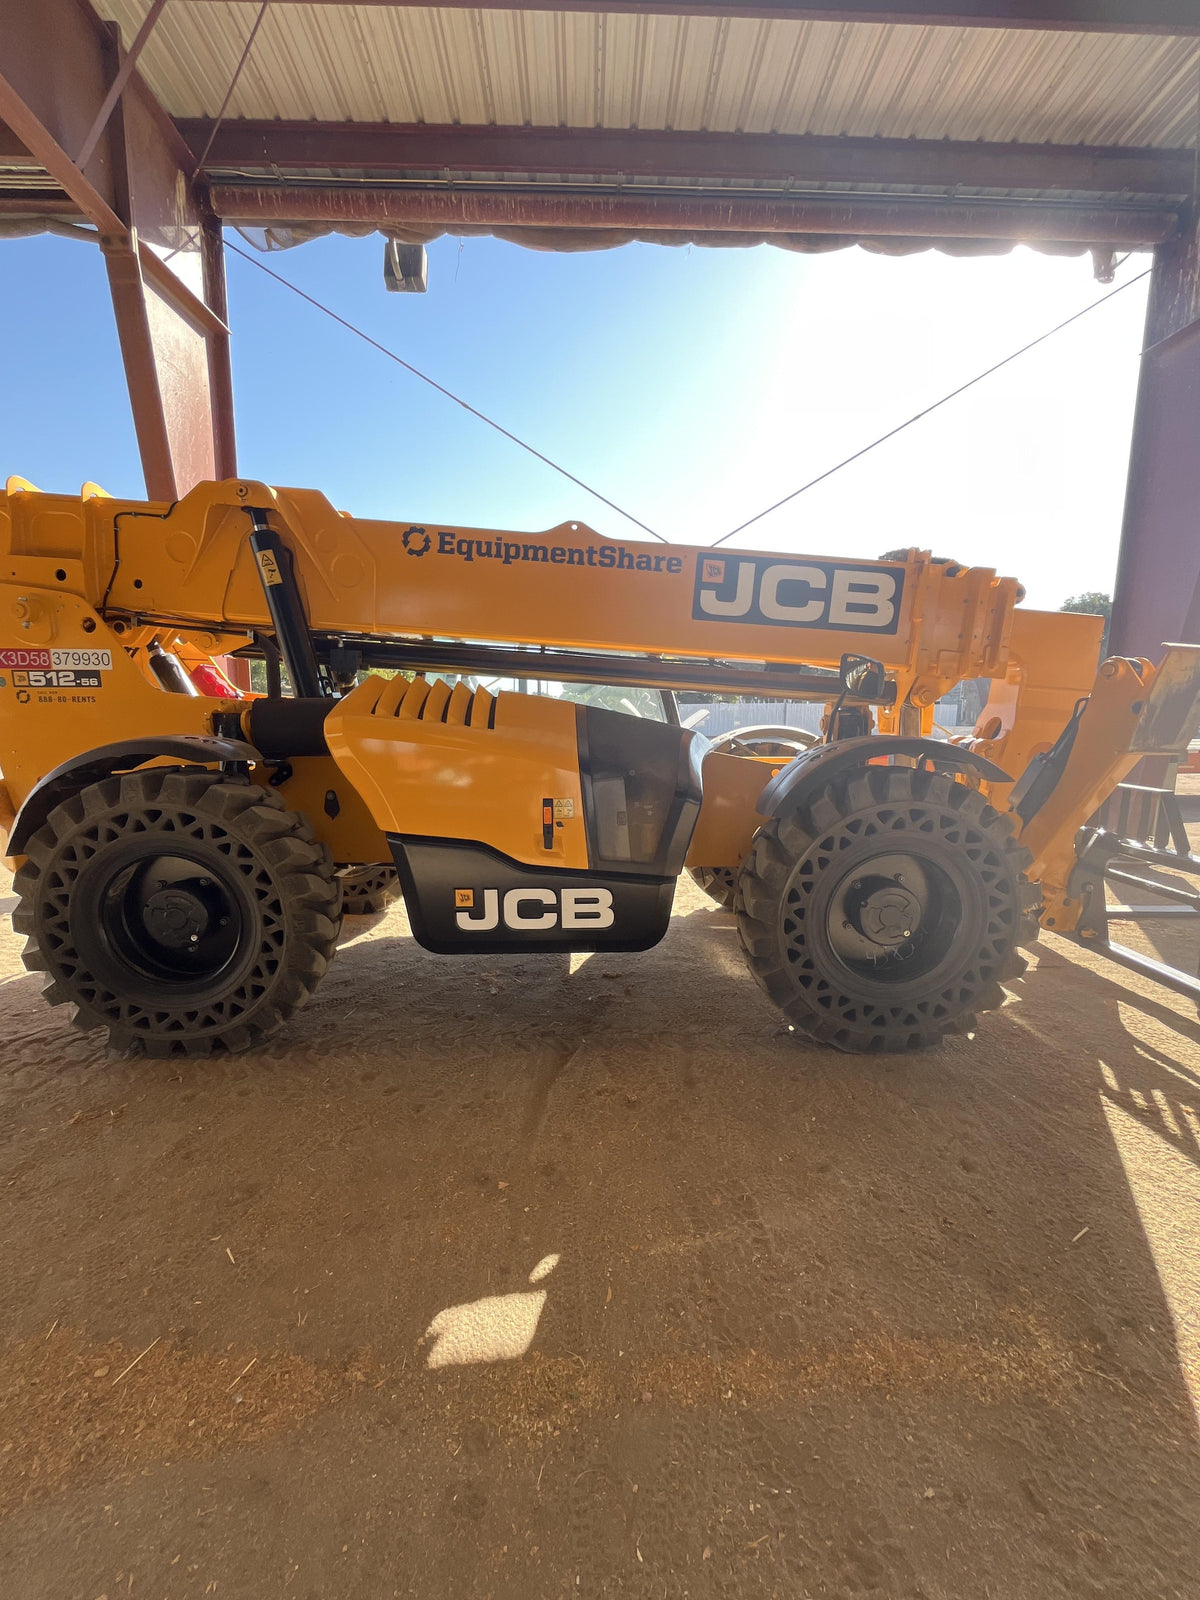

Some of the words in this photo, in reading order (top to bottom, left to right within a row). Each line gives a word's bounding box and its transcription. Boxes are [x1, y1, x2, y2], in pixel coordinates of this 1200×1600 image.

[437, 531, 683, 574] EquipmentShare
[700, 562, 896, 627] JCB
[0, 651, 50, 666] K3D58
[52, 652, 110, 666] 379930
[28, 671, 98, 687] 512-56
[456, 888, 615, 931] JCB
